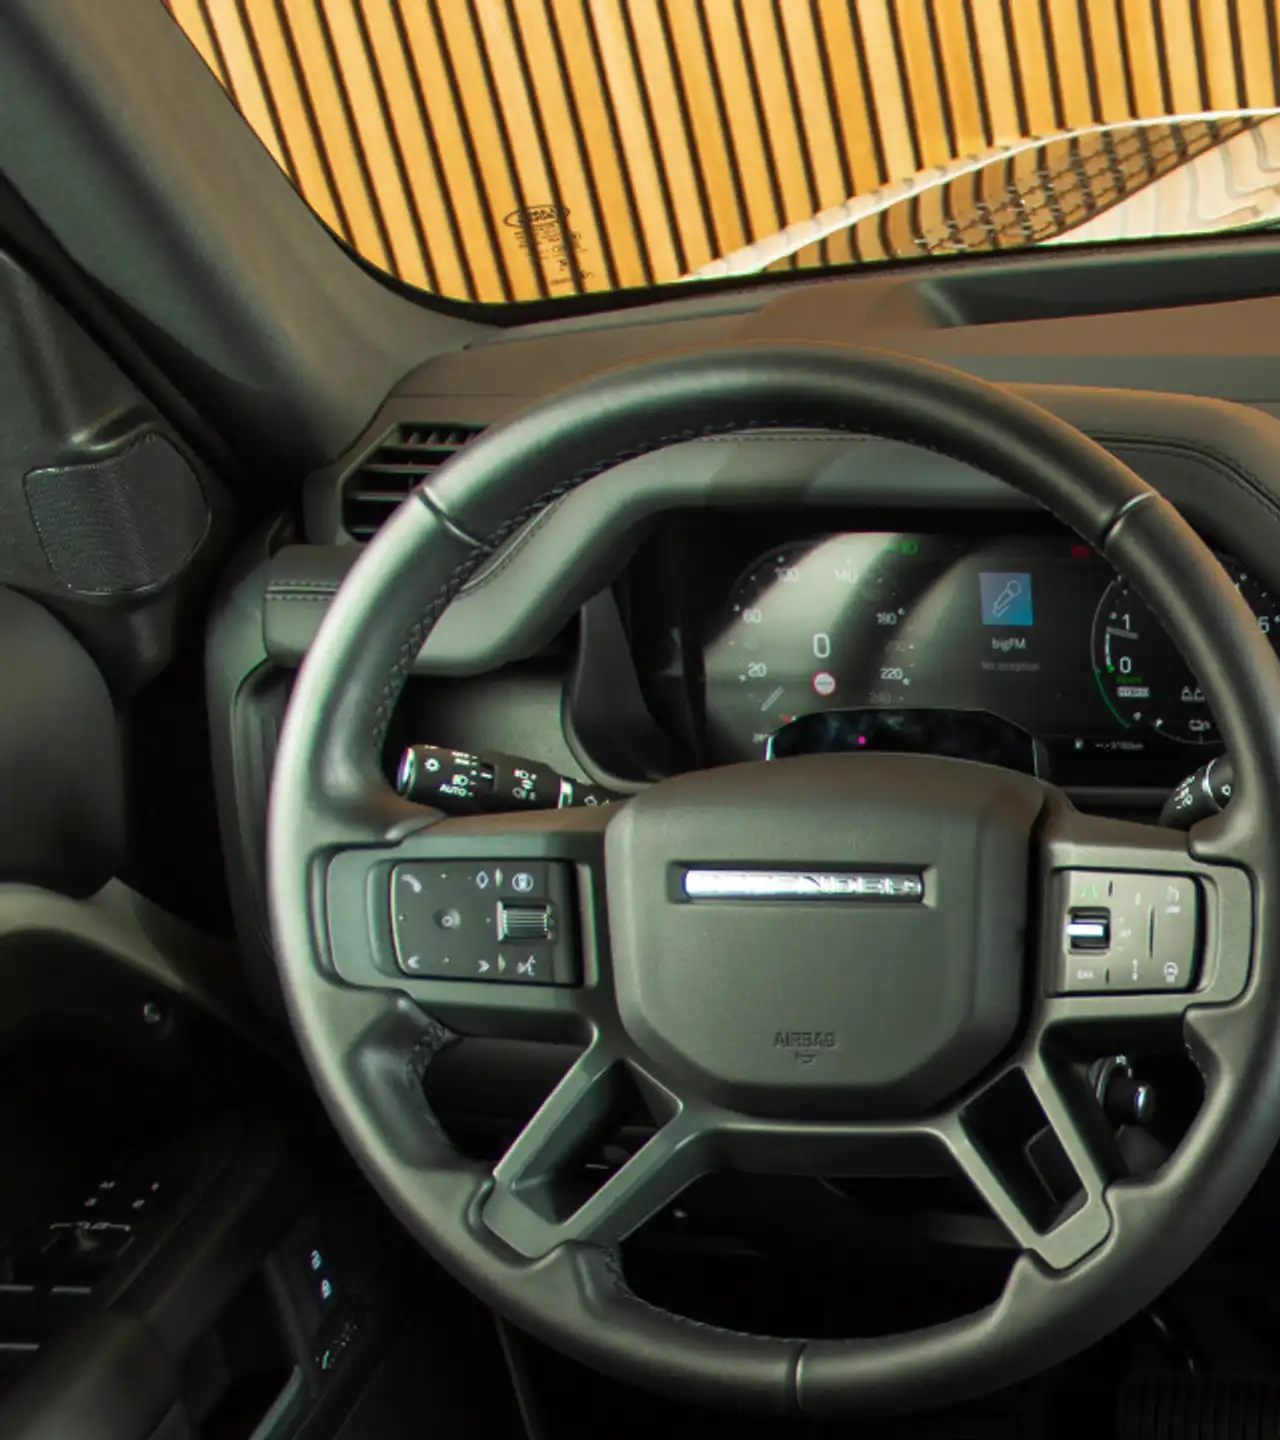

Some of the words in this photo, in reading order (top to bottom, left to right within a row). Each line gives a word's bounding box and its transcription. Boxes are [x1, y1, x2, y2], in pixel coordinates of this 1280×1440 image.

[1122, 613, 1131, 631] 1
[813, 633, 831, 659] 0
[747, 662, 767, 678] 20
[1120, 656, 1132, 674] 0
[880, 668, 904, 680] 220
[773, 1031, 837, 1048] AIRBAG
